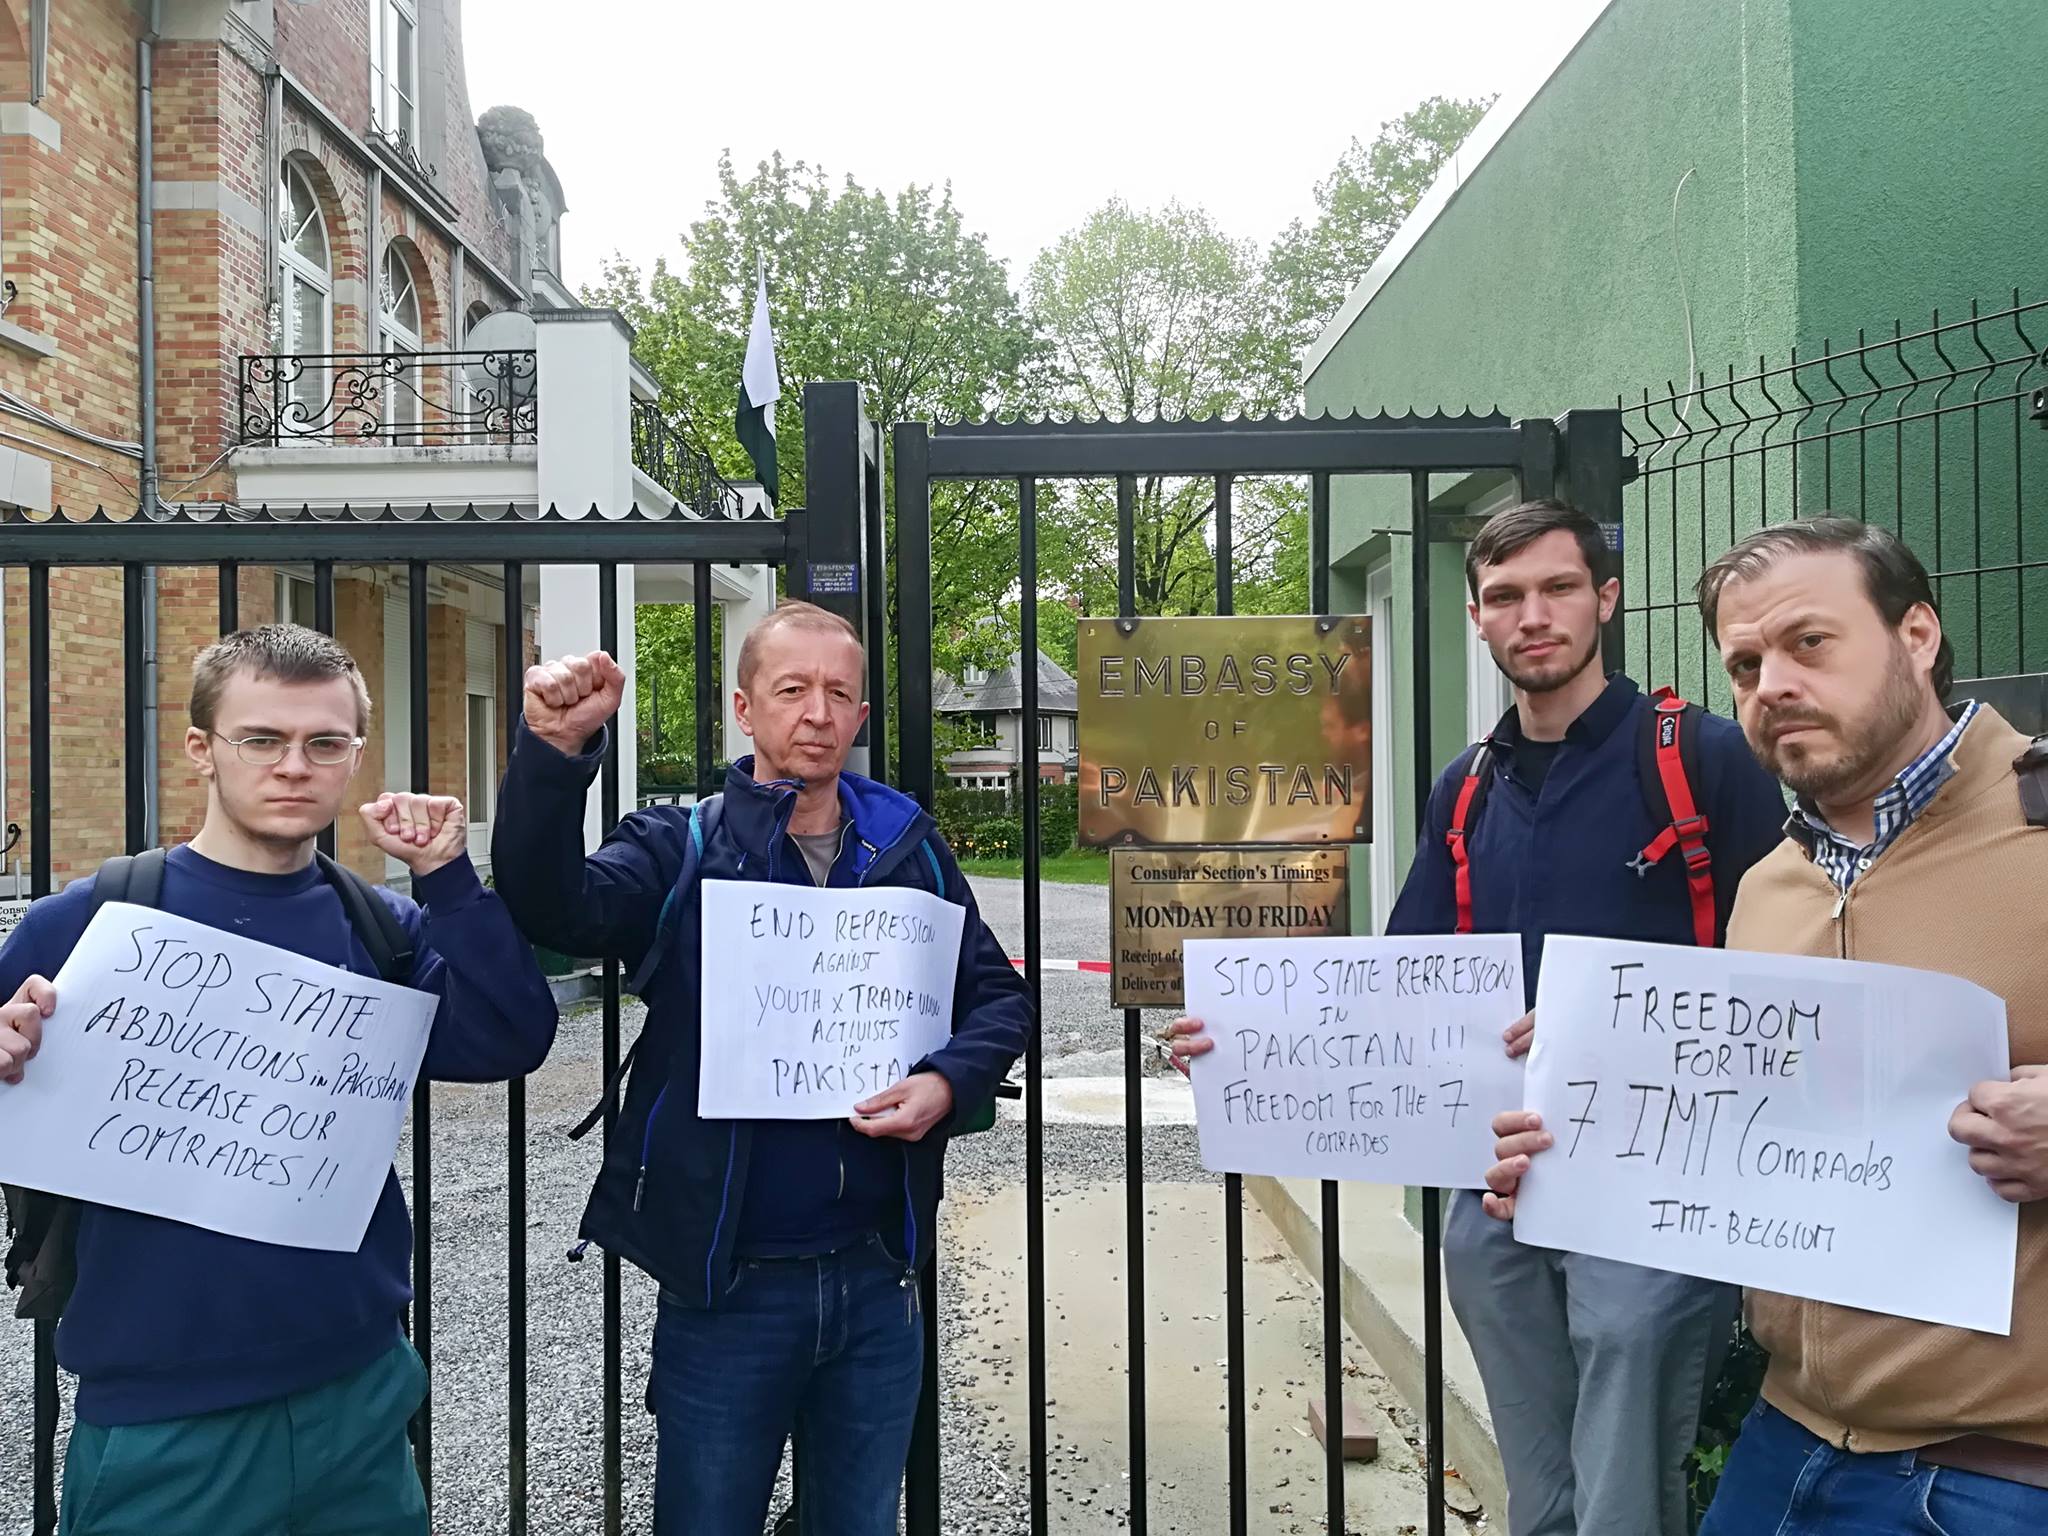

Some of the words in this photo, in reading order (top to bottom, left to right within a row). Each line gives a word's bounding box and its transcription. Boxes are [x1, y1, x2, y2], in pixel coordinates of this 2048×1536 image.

[1099, 653, 1351, 697] EMBASSY
[1204, 720, 1248, 741] OF
[1099, 763, 1352, 808] PAKISTAN
[1131, 865, 1197, 880] Consular
[1202, 864, 1266, 880] Section's
[1271, 864, 1330, 881] Timings
[750, 903, 814, 940] END
[836, 909, 935, 944] REPRESSION
[1125, 906, 1217, 928] MONDAY
[1224, 906, 1251, 928] TO
[1259, 905, 1335, 928] FRIDAY
[1121, 948, 1161, 966] Receipt
[1165, 949, 1177, 963] of
[114, 926, 232, 1018] STOP
[246, 972, 380, 1040] STATE
[1121, 976, 1166, 994] Delivery
[1214, 957, 1298, 1014] STOP
[1313, 959, 1381, 996] STATE
[1610, 962, 1820, 1041] FREEDOM
[755, 984, 822, 1028] YOUTH
[848, 984, 913, 1014] TRADE
[1319, 1006, 1348, 1026] IN
[771, 1056, 912, 1098] PAKISTA
[1674, 1039, 1732, 1077] FOR
[1742, 1043, 1803, 1077] THE
[110, 1058, 259, 1124] RELEASE
[260, 1104, 336, 1141] OUR
[1224, 1079, 1333, 1125] FREEDOM
[1348, 1082, 1384, 1121] FOR
[1392, 1084, 1427, 1117] THE
[1439, 1080, 1469, 1127] 7
[1306, 1131, 1388, 1156] COMRADES
[1567, 1081, 1598, 1158] 7
[1614, 1082, 1740, 1177] IMT
